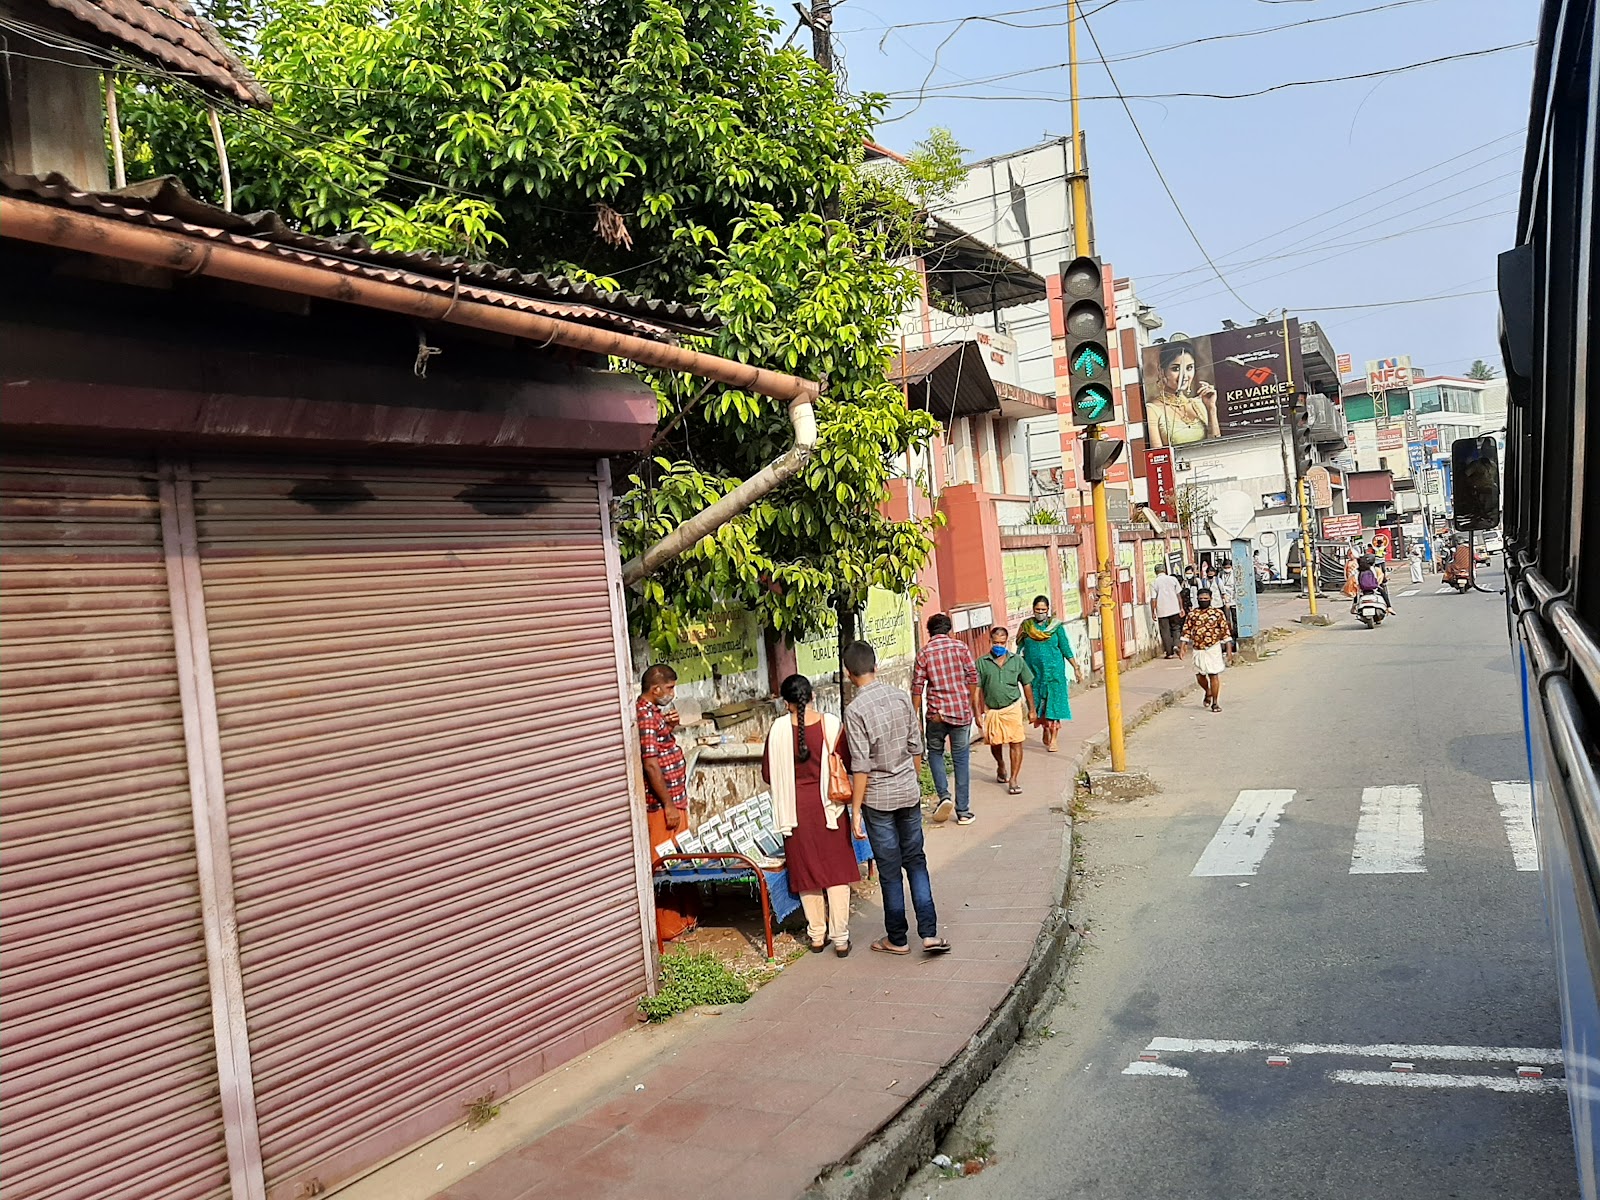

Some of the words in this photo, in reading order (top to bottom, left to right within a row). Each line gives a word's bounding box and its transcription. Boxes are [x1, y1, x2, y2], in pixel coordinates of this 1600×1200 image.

[1370, 367, 1408, 384] NFC
[1372, 380, 1409, 391] FINANCE
[1406, 410, 1415, 437] HOTEL
[1156, 466, 1166, 505] KERALA
[812, 646, 831, 661] RURAL
